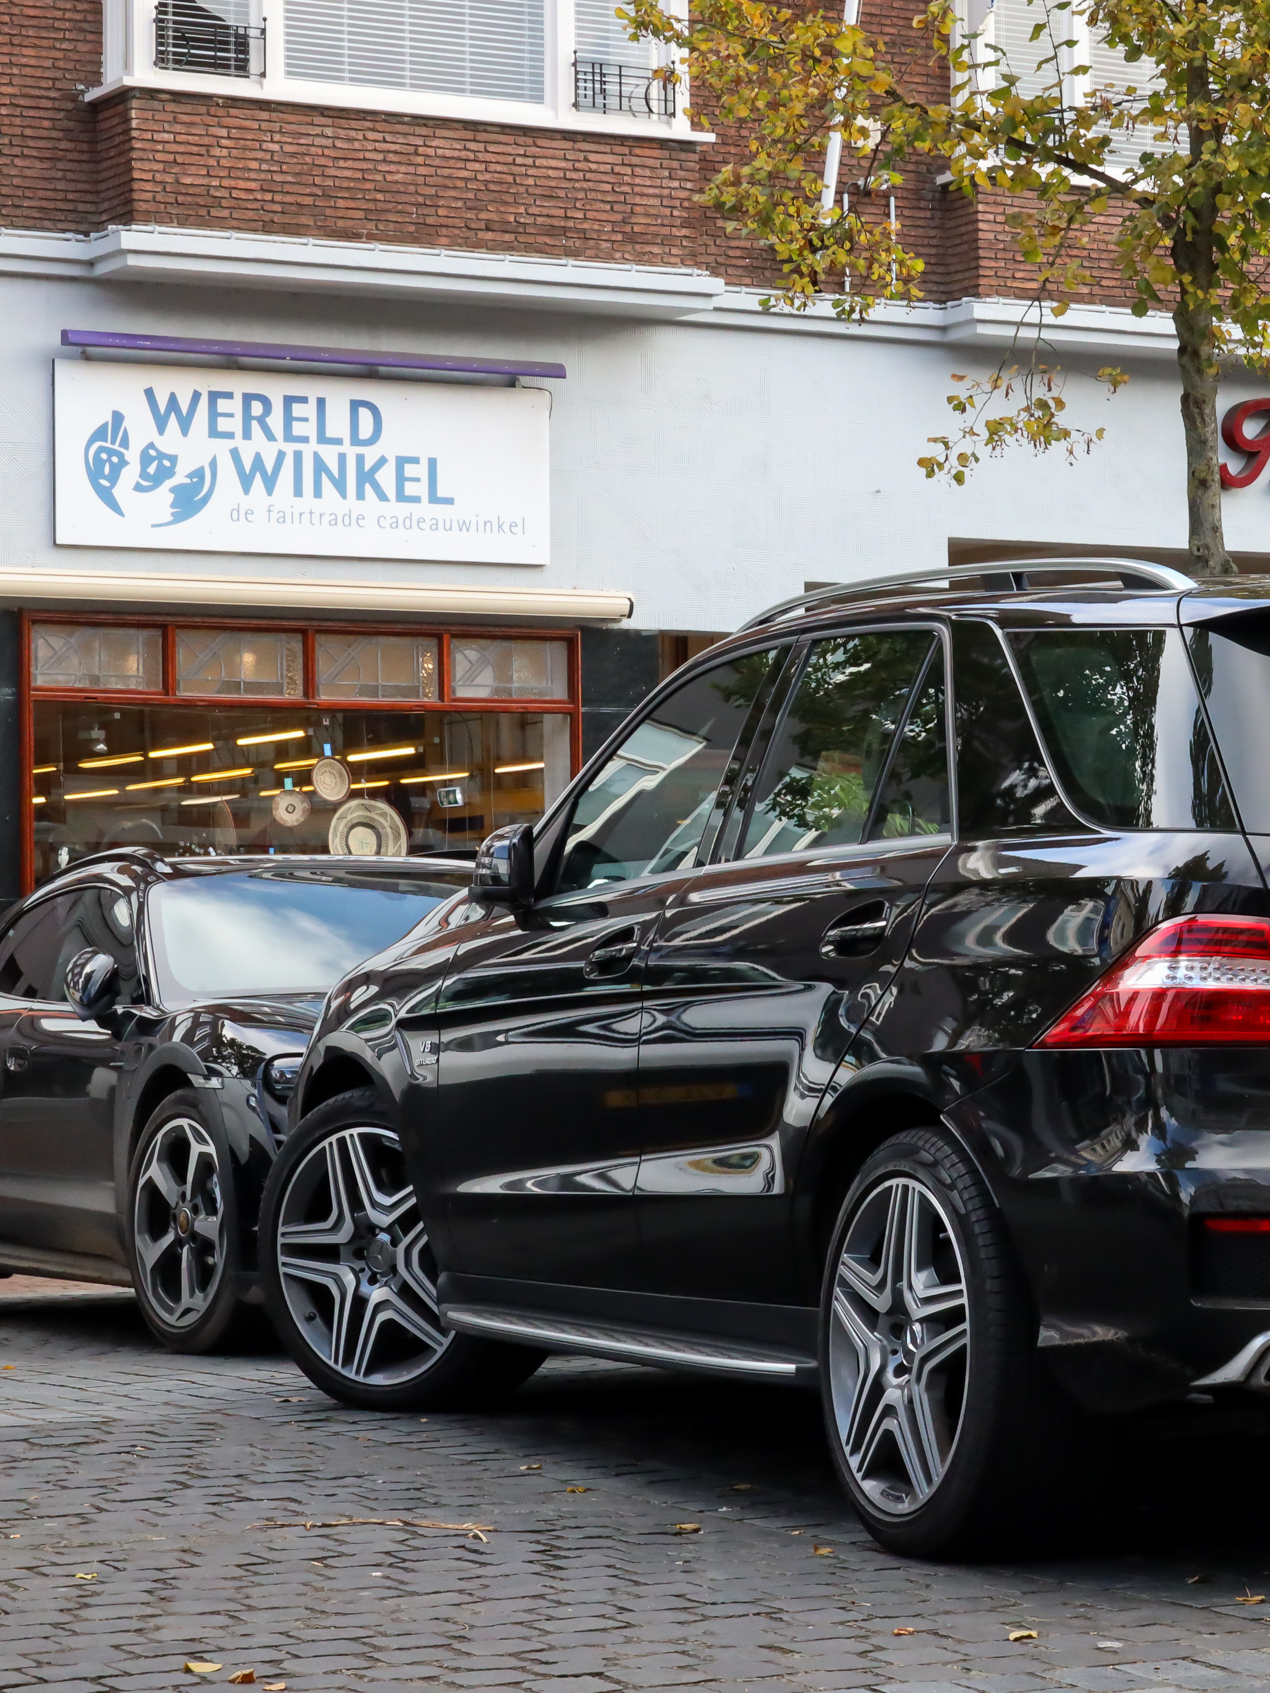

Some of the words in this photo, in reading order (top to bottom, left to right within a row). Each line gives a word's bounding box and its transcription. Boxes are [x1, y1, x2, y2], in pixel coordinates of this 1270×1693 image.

[143, 386, 383, 447] WERELD
[229, 446, 455, 505] WINKEL
[230, 503, 254, 523] de
[266, 504, 365, 528] fairtrade
[377, 511, 525, 535] cadeauwinkel
